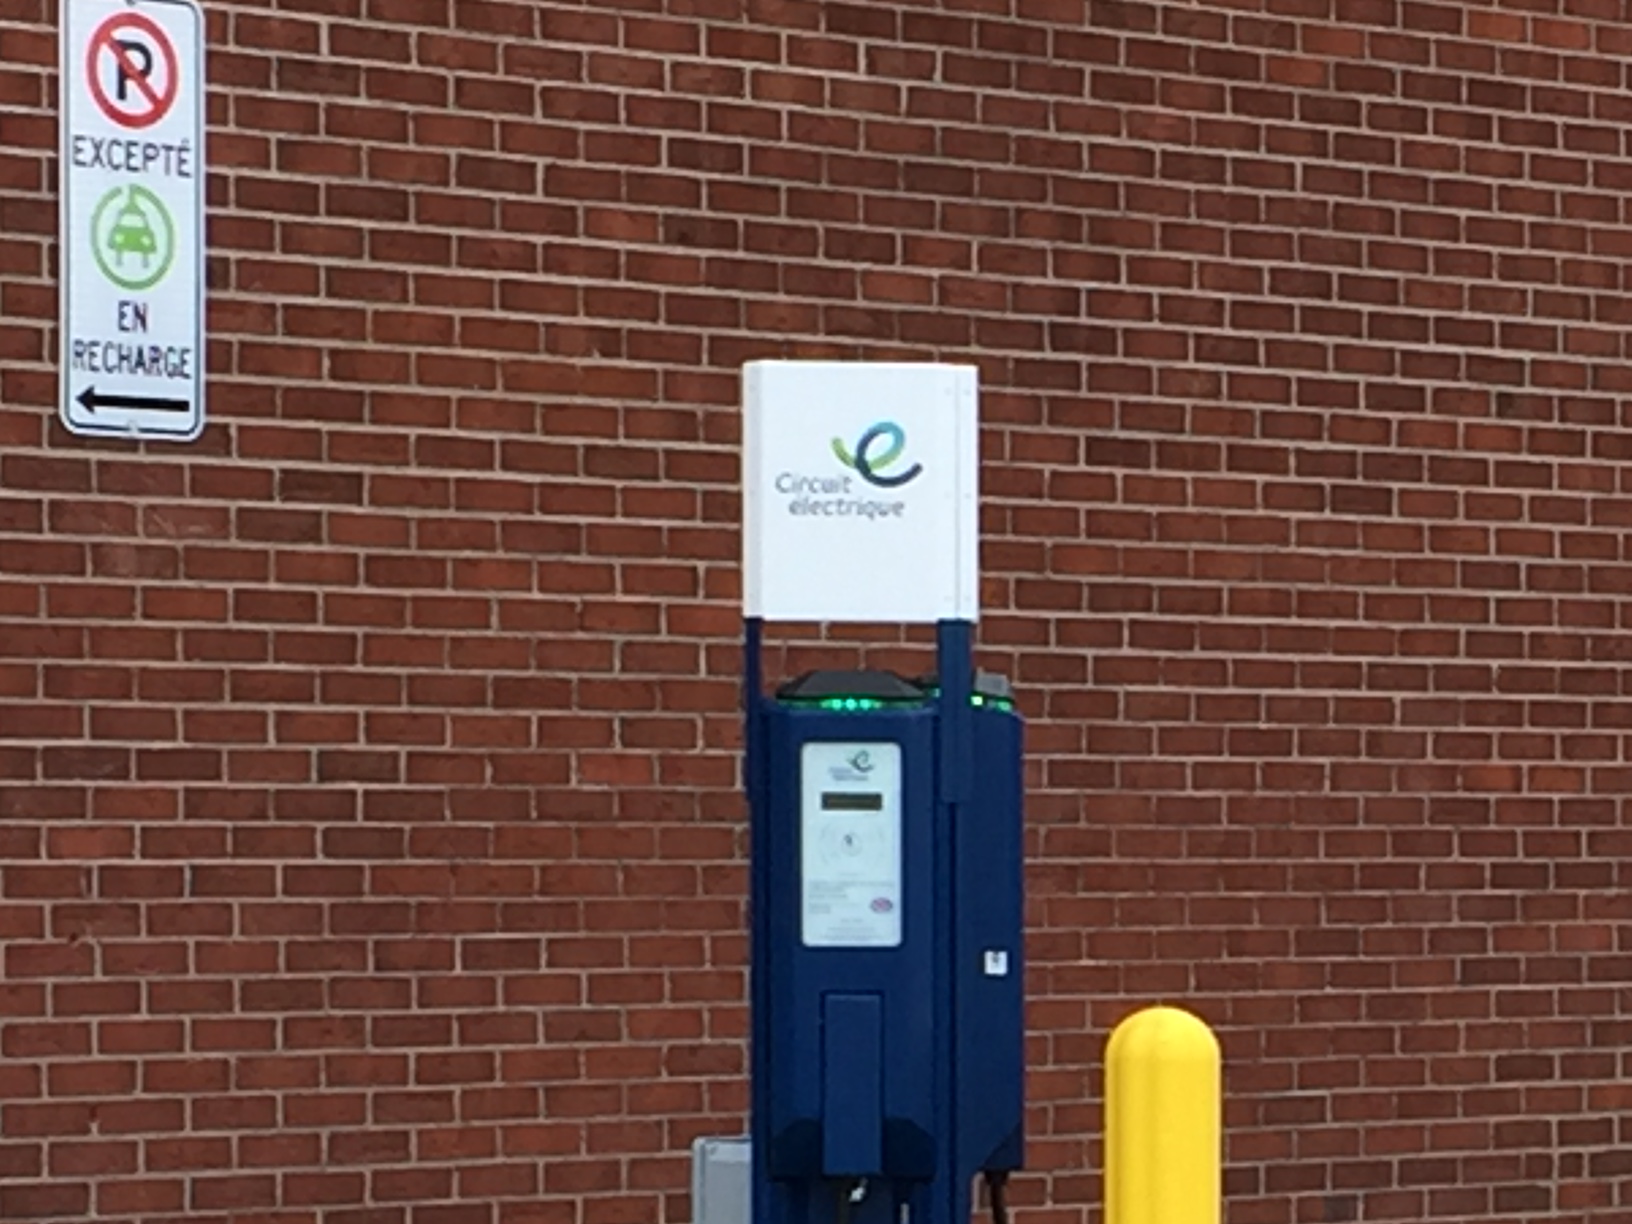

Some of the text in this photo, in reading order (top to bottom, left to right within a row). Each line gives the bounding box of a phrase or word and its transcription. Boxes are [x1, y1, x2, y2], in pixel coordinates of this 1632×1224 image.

[71, 134, 193, 178] EXCEPTÉ
[116, 300, 148, 333] EN
[71, 339, 192, 380] RECHARGE
[774, 472, 852, 495] Circuit
